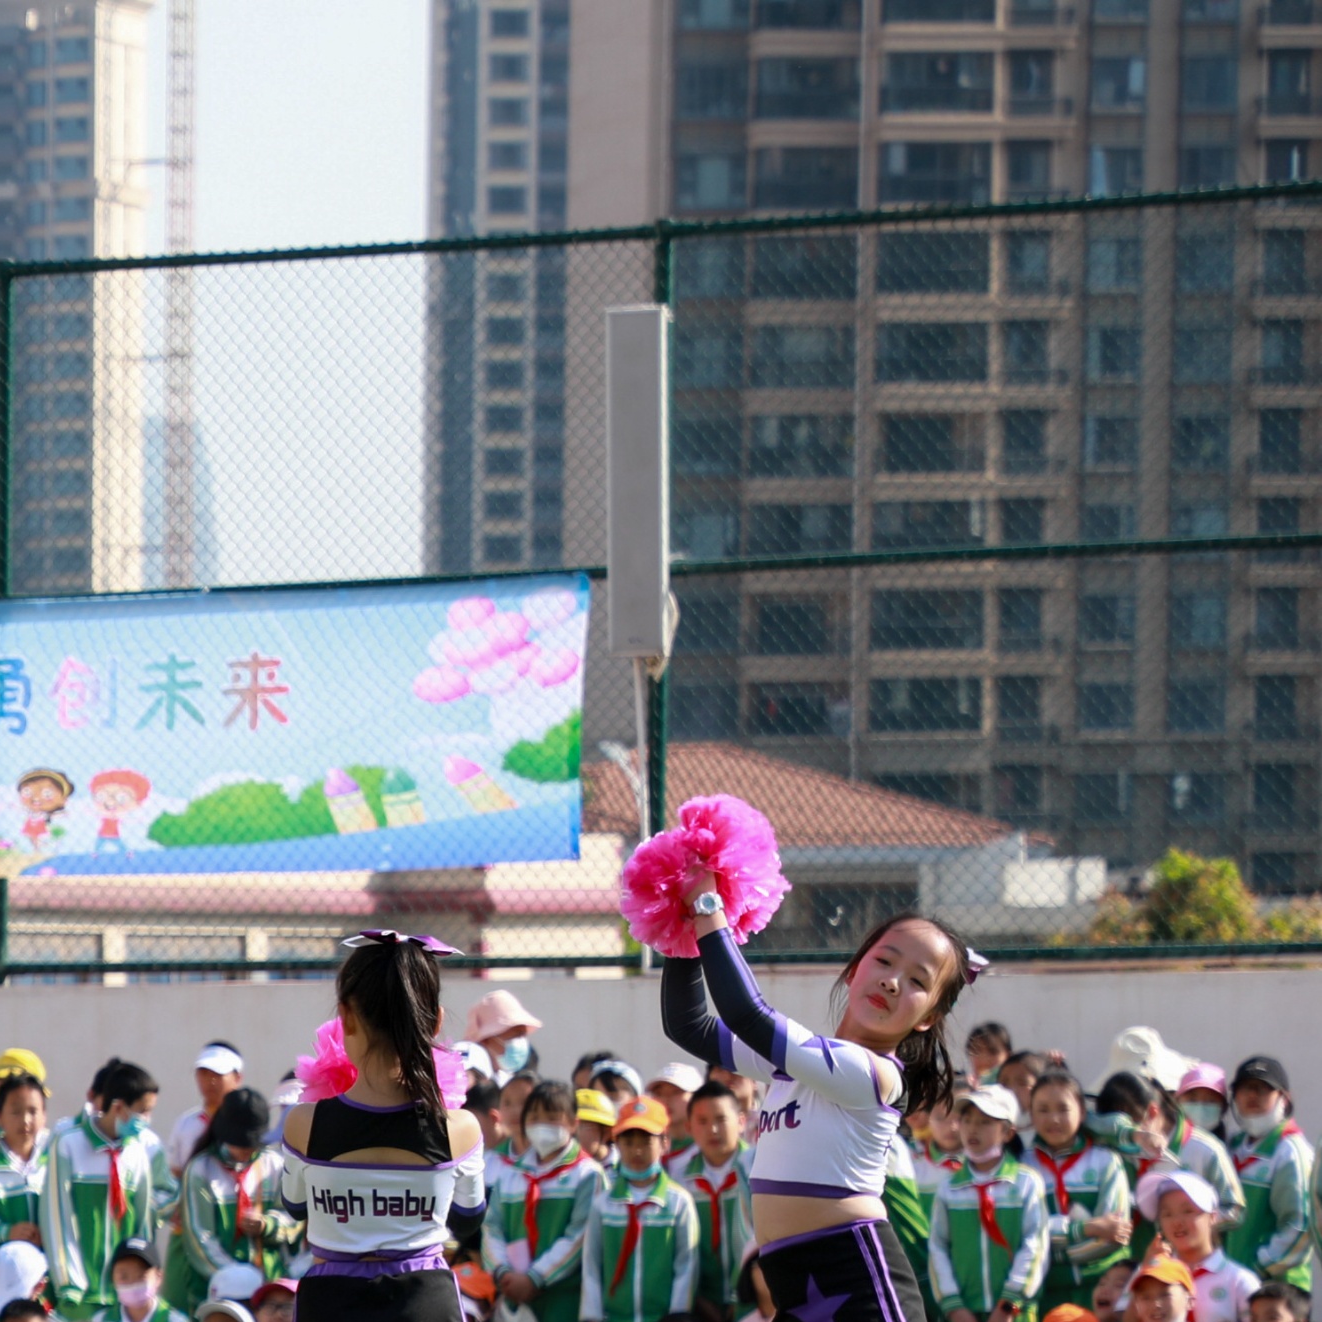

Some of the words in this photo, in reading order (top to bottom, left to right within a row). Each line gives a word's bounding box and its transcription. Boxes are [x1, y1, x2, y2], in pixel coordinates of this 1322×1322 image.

[757, 1099, 802, 1138] port
[311, 1185, 366, 1224] High
[372, 1188, 437, 1223] baby
